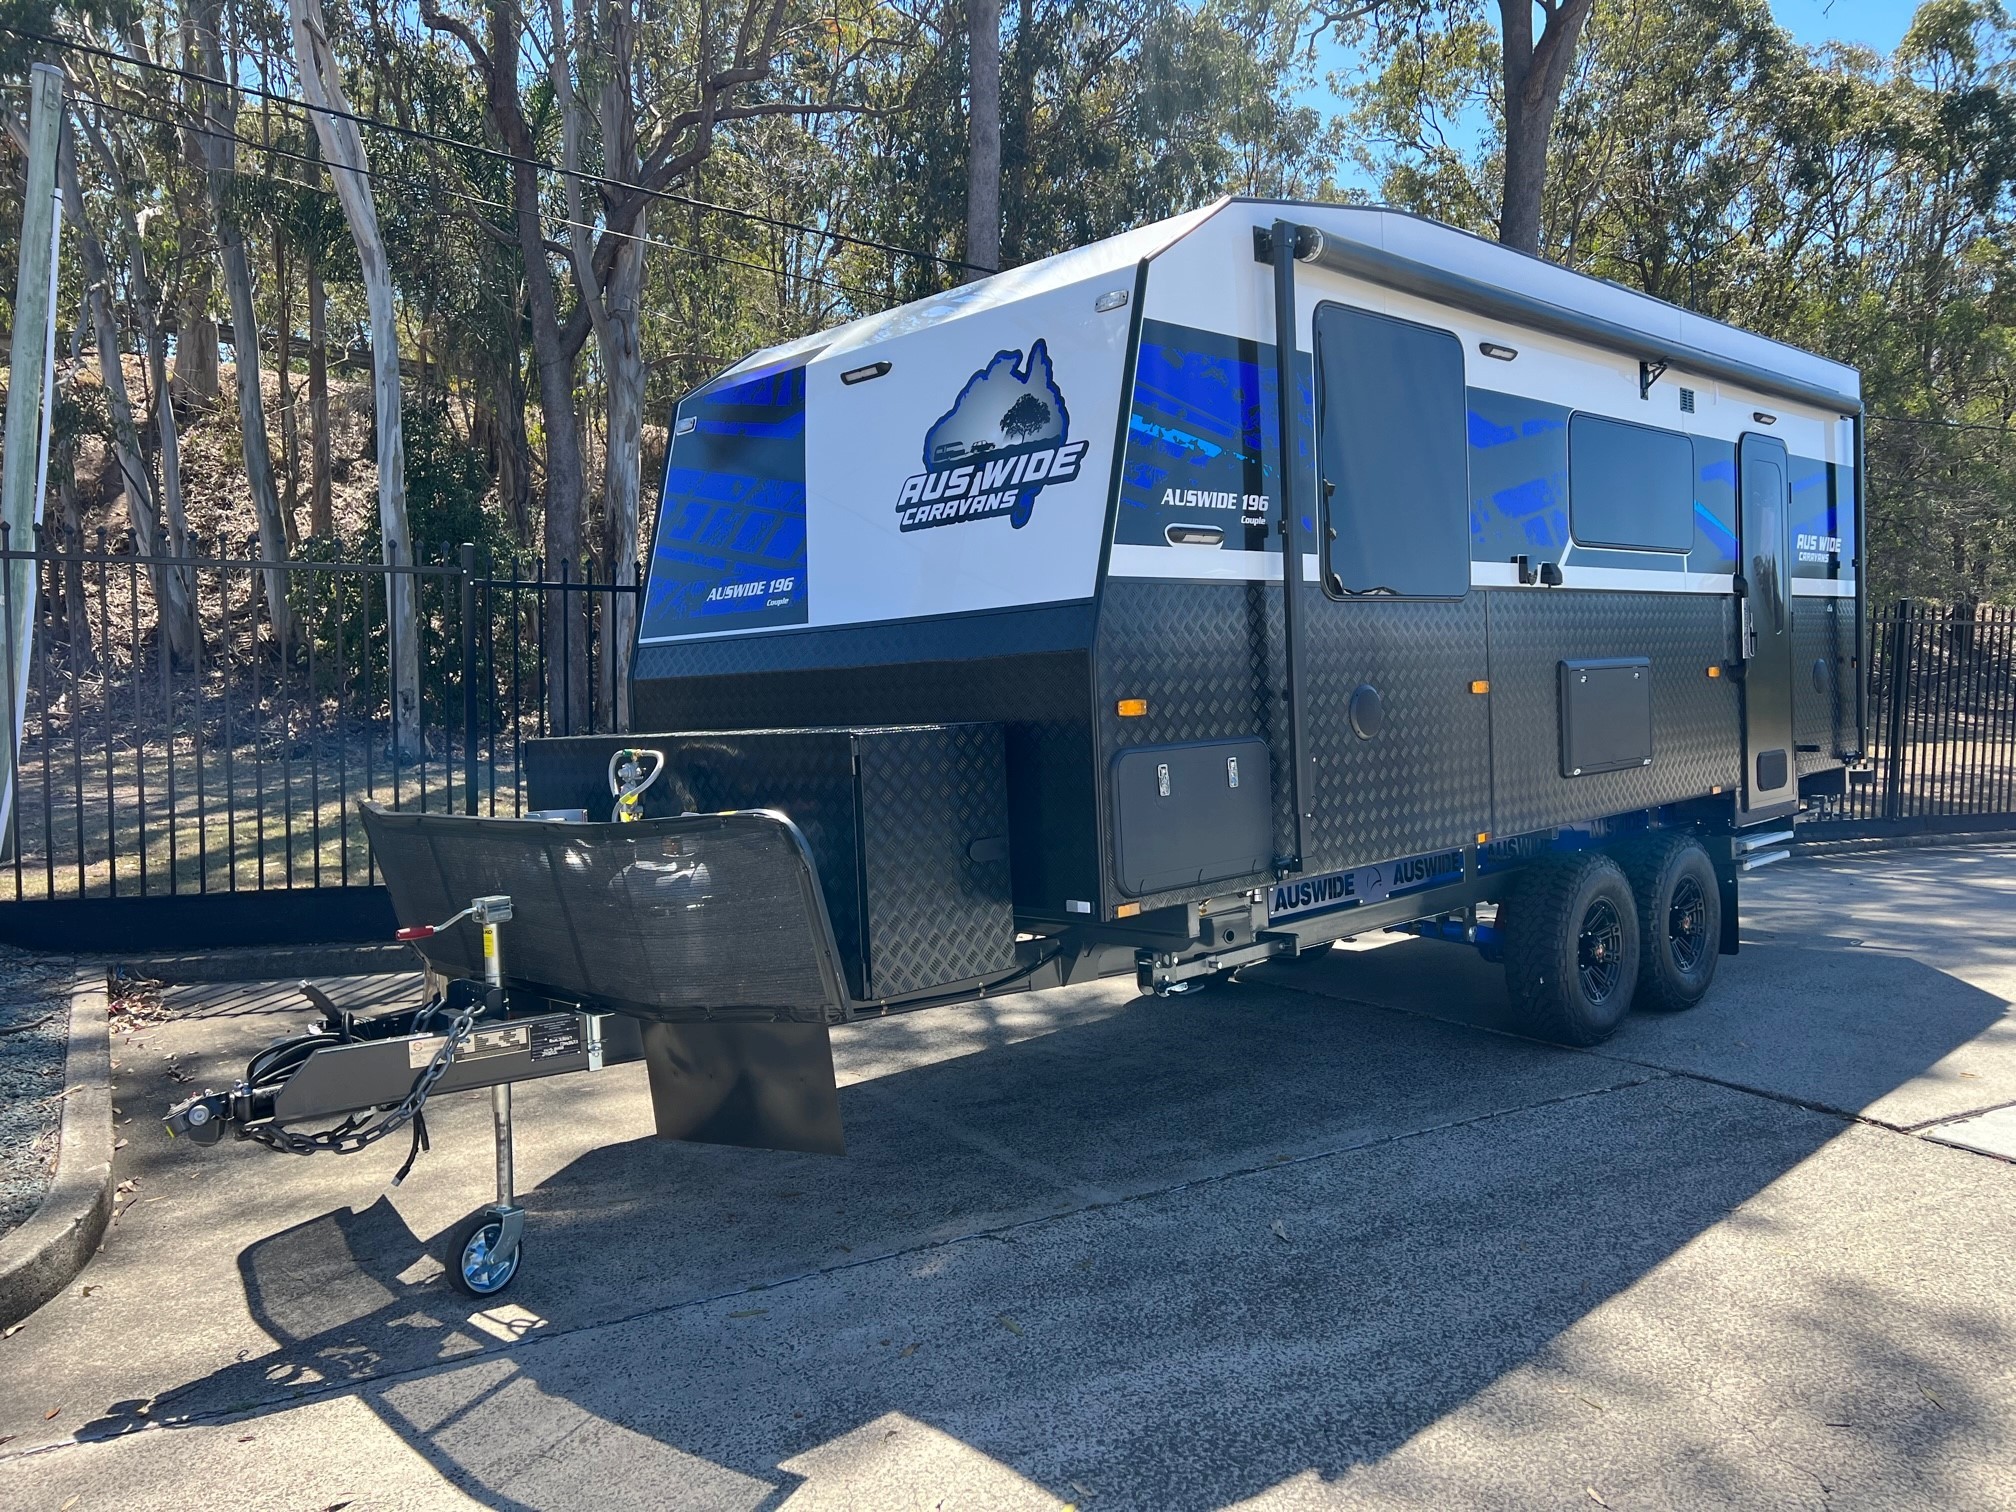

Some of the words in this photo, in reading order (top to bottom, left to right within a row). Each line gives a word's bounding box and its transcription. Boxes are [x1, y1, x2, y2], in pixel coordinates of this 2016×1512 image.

[901, 489, 1019, 526] CARAVANS
[1161, 488, 1238, 510] AUSWIDE
[1241, 494, 1270, 512] 196
[1240, 515, 1266, 527] Couple
[1796, 533, 1818, 551] AUS
[1819, 536, 1842, 553] WIDE
[1798, 551, 1830, 563] CARAVANS
[706, 580, 767, 602] AUSWIDE
[768, 577, 795, 594] 196
[766, 597, 790, 607] Couple
[1487, 837, 1550, 862] AUSWID
[1393, 852, 1459, 886] AUSWIDE
[1274, 873, 1355, 912] AUSWIDE
